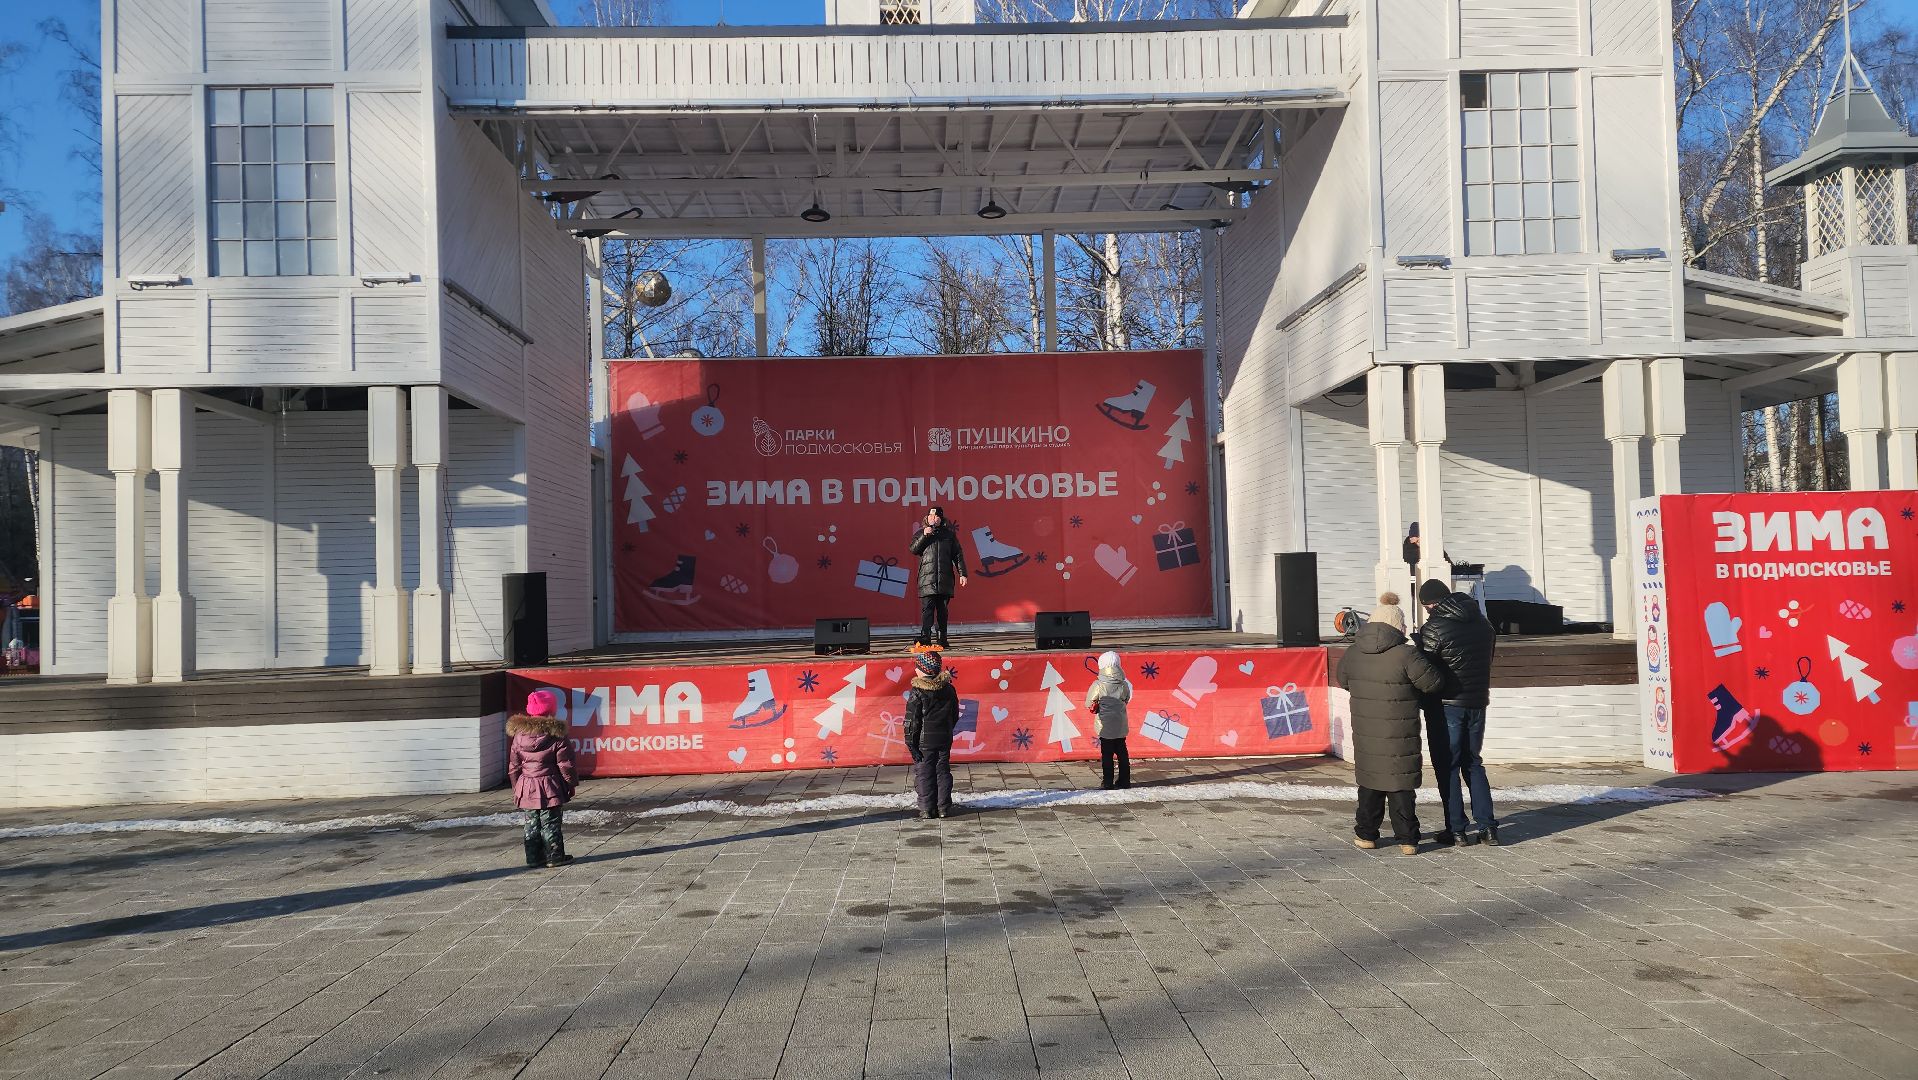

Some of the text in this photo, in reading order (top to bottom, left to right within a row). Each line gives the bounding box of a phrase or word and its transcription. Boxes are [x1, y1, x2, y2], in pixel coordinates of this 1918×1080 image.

[785, 429, 835, 441] ПАРКИ
[957, 425, 1070, 444] ПУШКИНО
[785, 442, 902, 455] ПОДМОСКОВЬЯ
[707, 471, 1119, 506] ЗИМА В ПОДМОСКОВЬЕ
[1712, 507, 1890, 553] ЗИМА
[1716, 560, 1892, 581] В ПОДМОСКОВЬЕ
